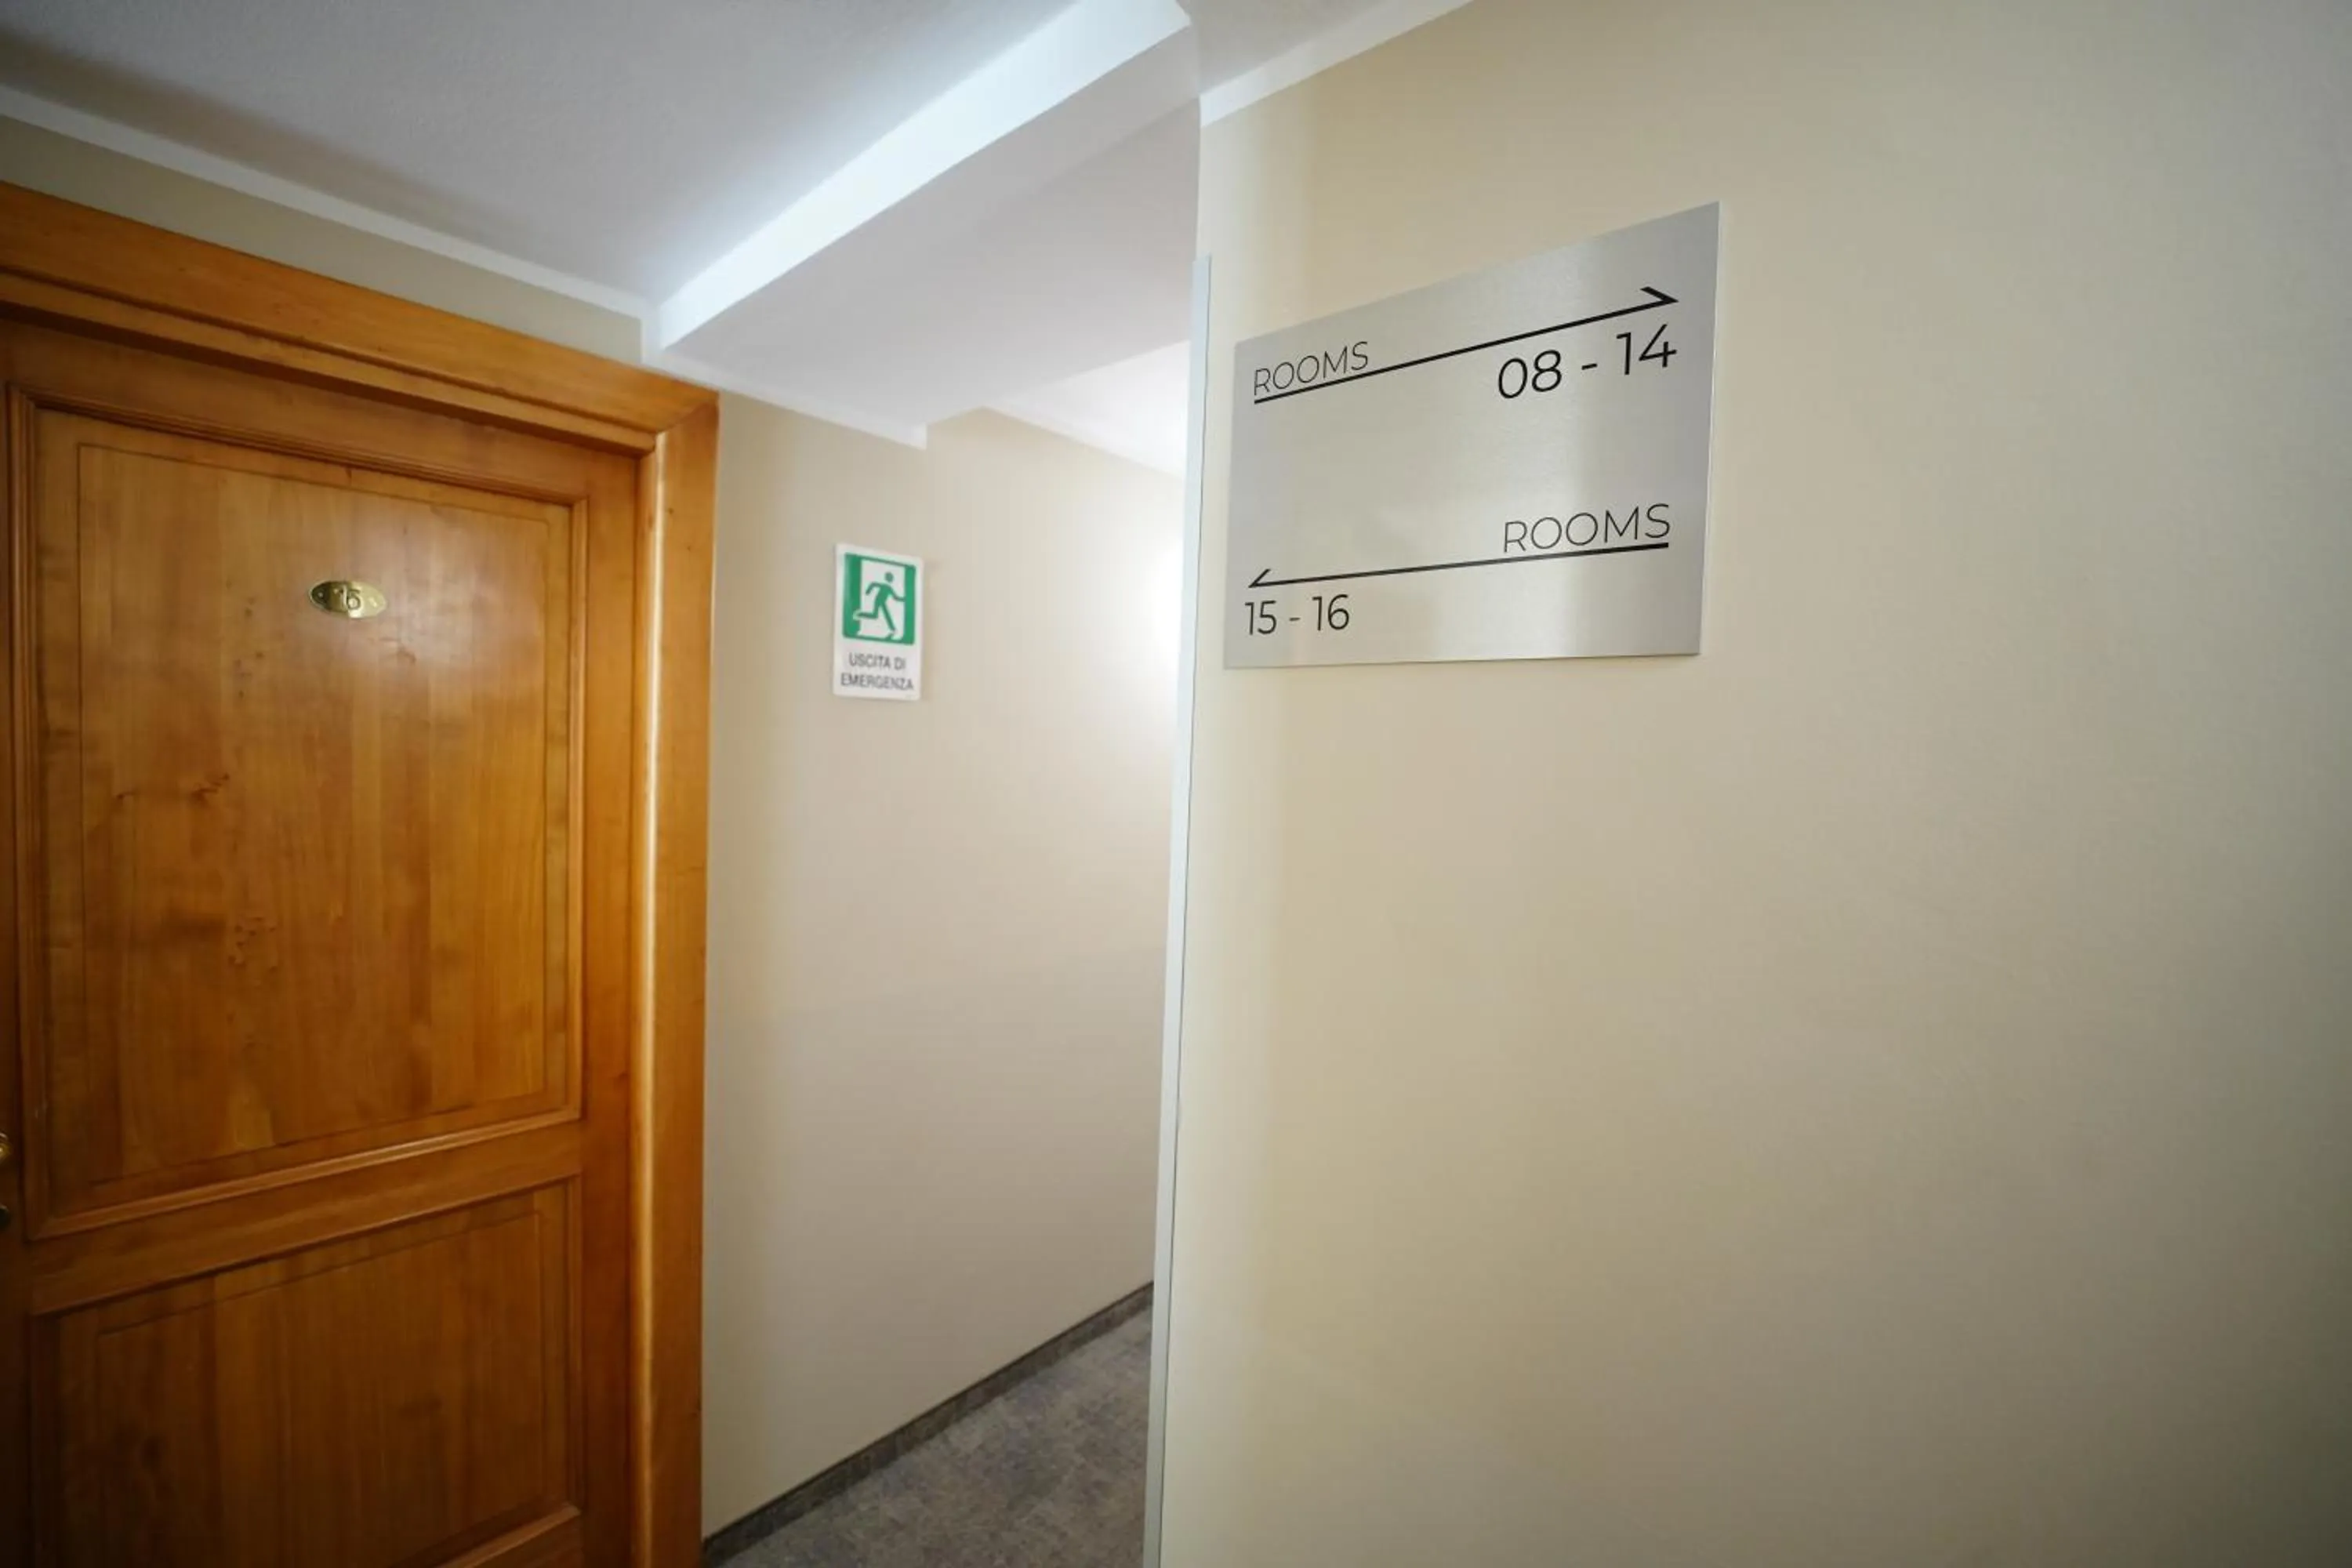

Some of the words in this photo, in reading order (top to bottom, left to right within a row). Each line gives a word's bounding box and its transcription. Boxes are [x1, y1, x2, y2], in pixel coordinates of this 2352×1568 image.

[1254, 340, 1370, 397] ROOMS
[1497, 349, 1563, 400] 08
[1615, 323, 1678, 376] 14
[1503, 503, 1671, 554] ROOMS
[1244, 599, 1278, 636] 15
[1312, 593, 1351, 632] 16
[840, 672, 913, 691] EMERGENZA
[848, 652, 891, 670] USCITA
[894, 656, 906, 671] DI
